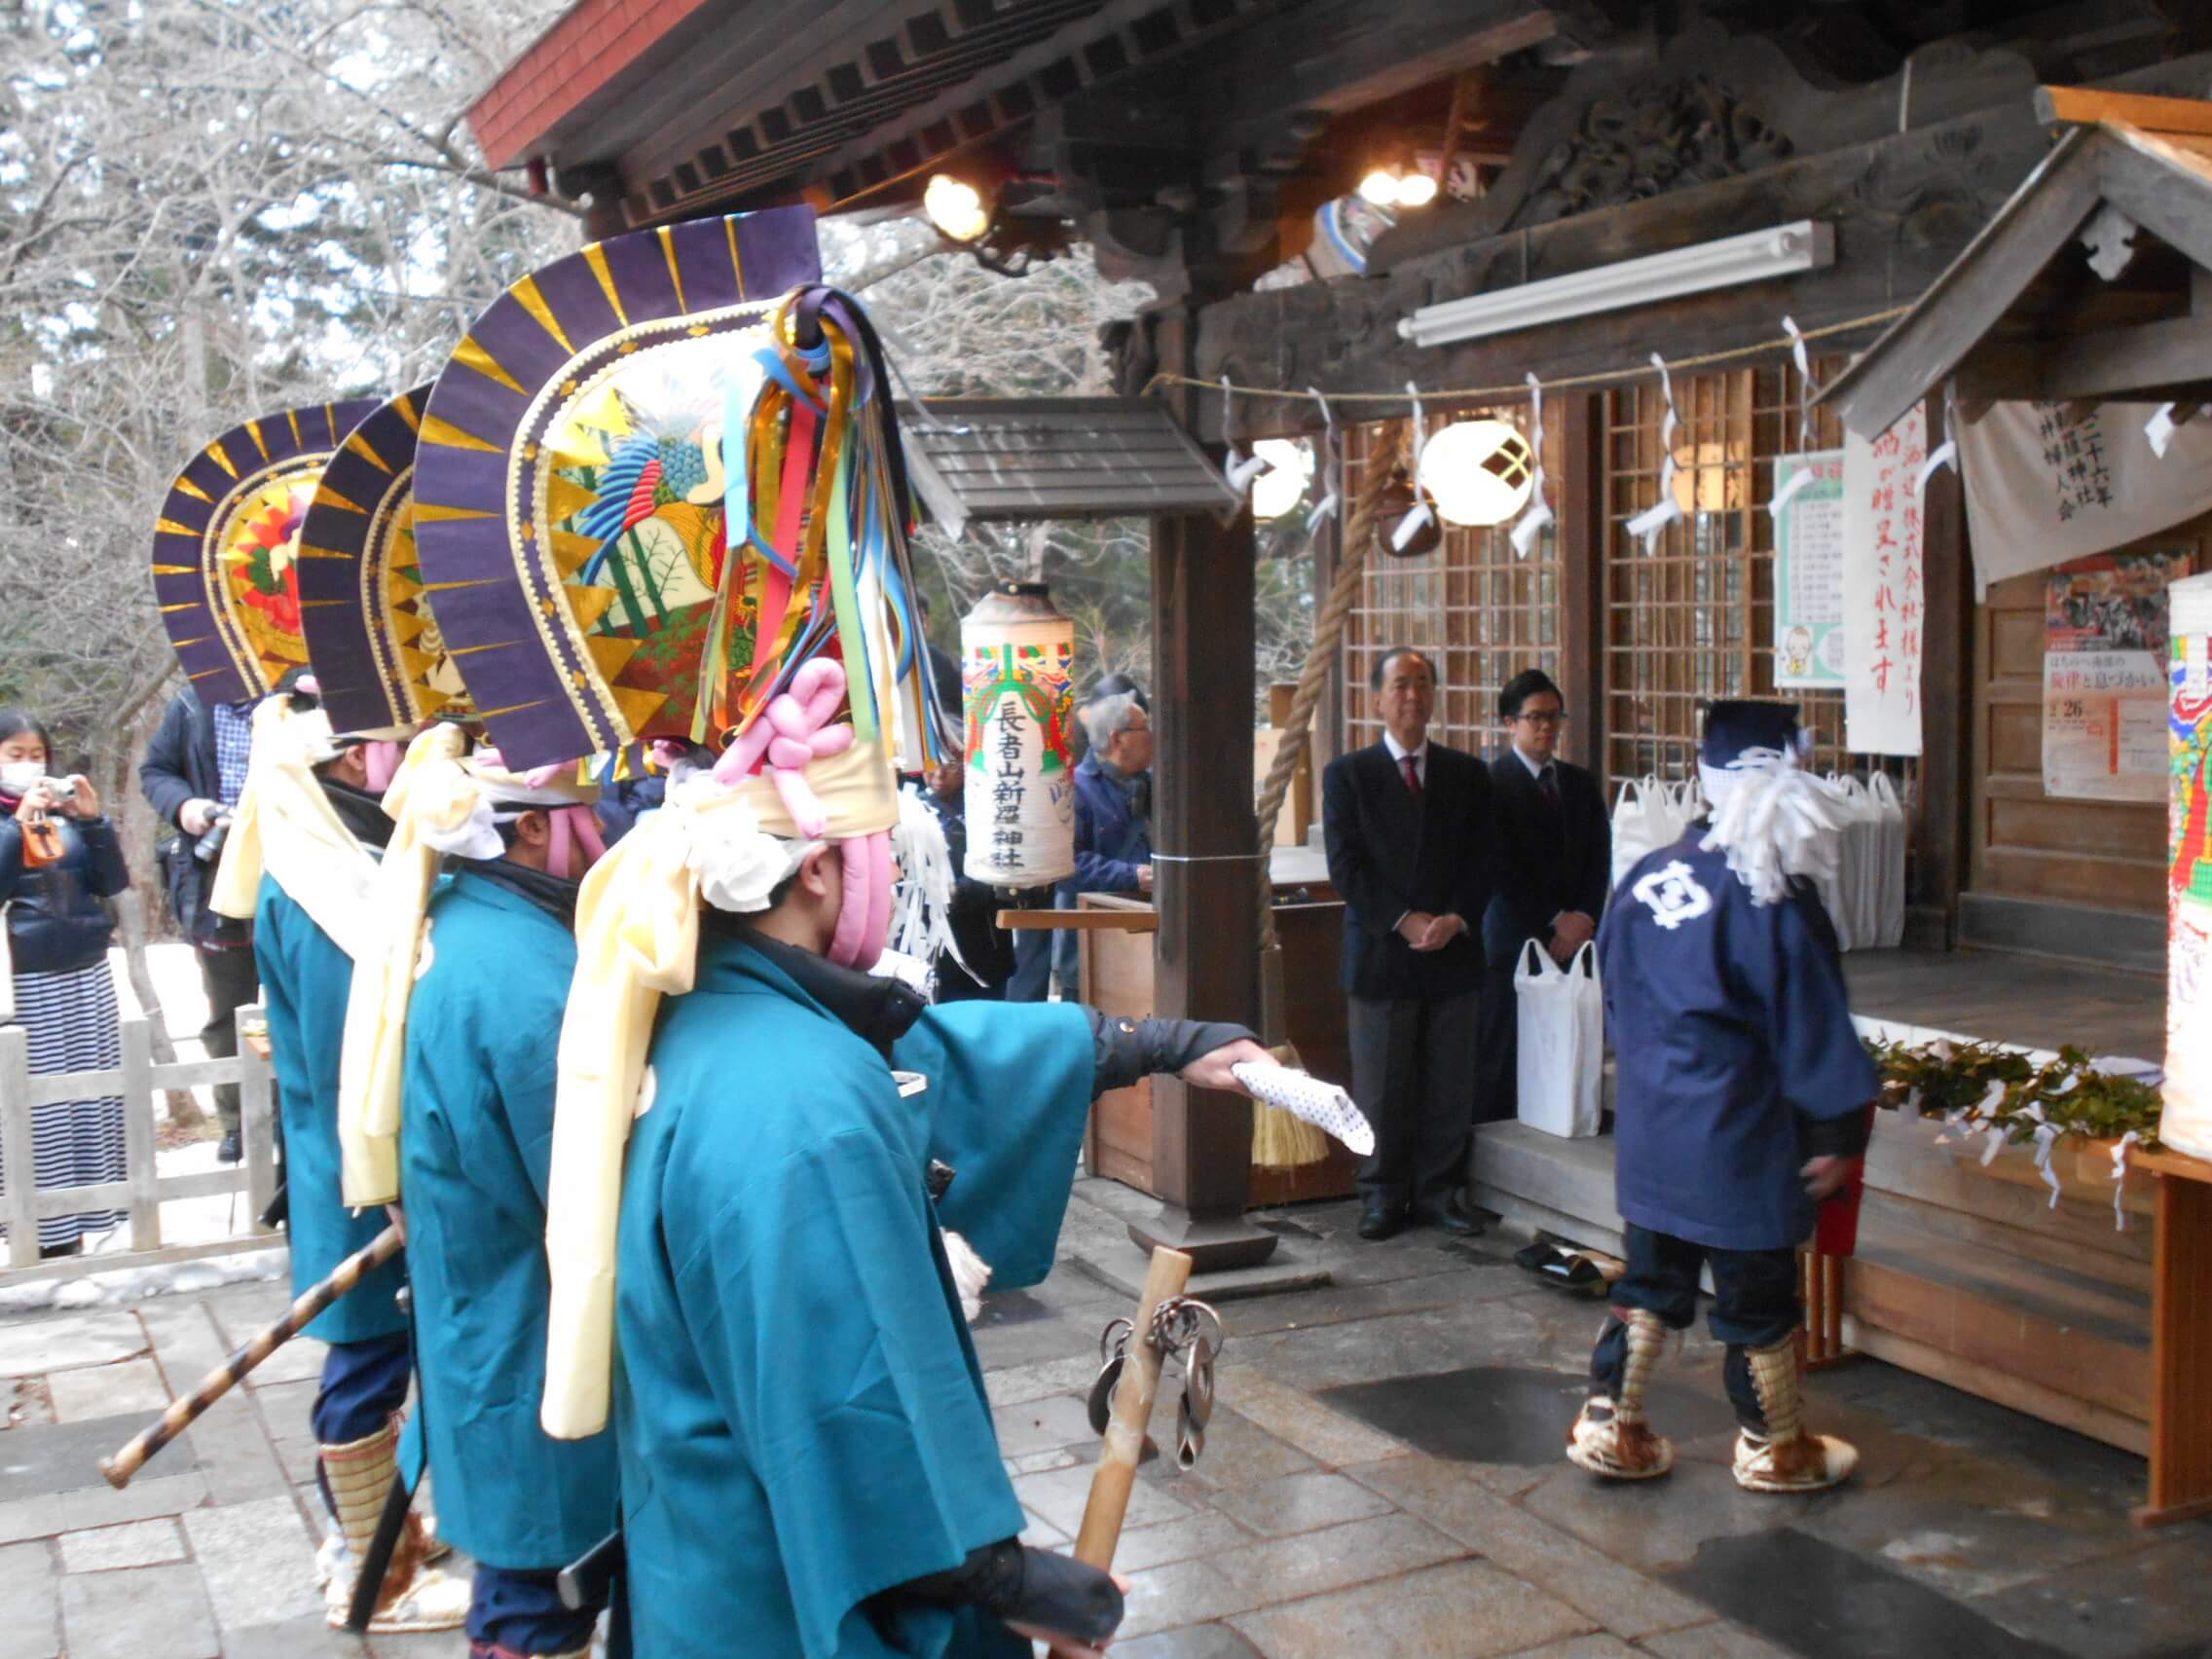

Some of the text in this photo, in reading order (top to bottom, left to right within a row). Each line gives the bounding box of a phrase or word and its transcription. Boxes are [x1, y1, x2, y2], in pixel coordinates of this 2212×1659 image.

[2063, 700, 2083, 718] 26
[990, 700, 1025, 868] 長者山新羅神社
